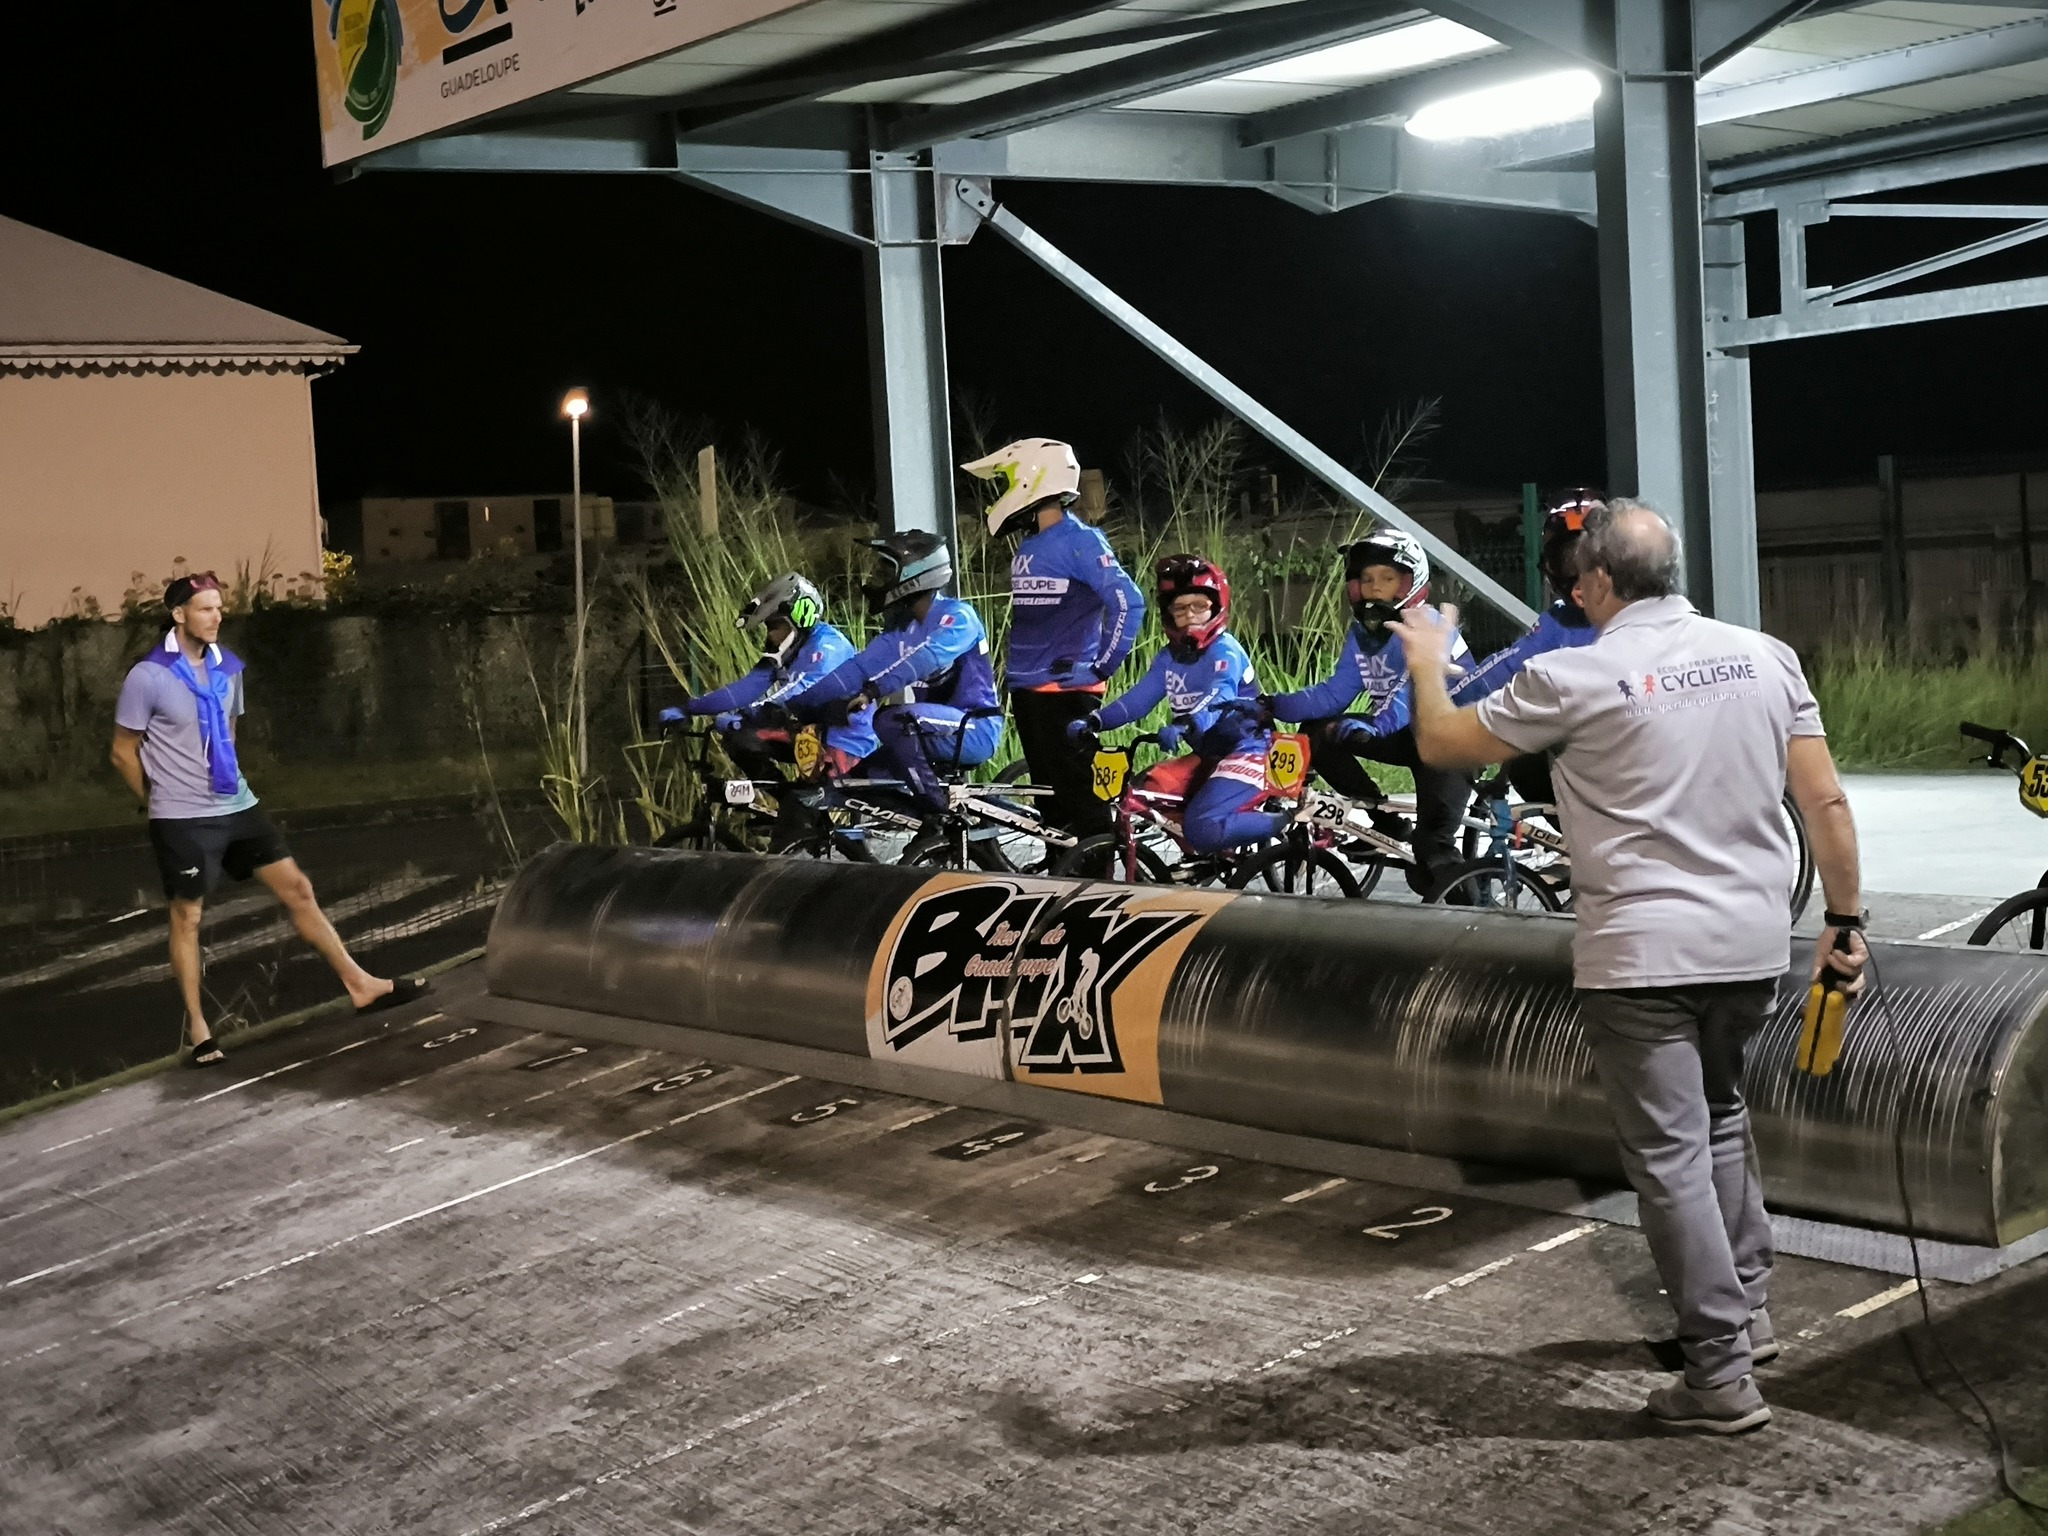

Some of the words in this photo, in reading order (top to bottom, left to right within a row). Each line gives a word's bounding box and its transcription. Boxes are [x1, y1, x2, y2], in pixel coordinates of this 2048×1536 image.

[440, 53, 520, 98] GUADELOUPE
[1011, 554, 1034, 575] MX
[1661, 664, 1757, 692] CYCLISME
[845, 798, 923, 830] CHASE
[1313, 800, 1345, 826] 29B
[1041, 922, 1067, 945] de
[883, 881, 1206, 1074] BMX
[964, 953, 1057, 983] Guadeoupe
[791, 1098, 858, 1123] 5
[1144, 1165, 1219, 1192] 3
[1362, 1206, 1454, 1240] 2
